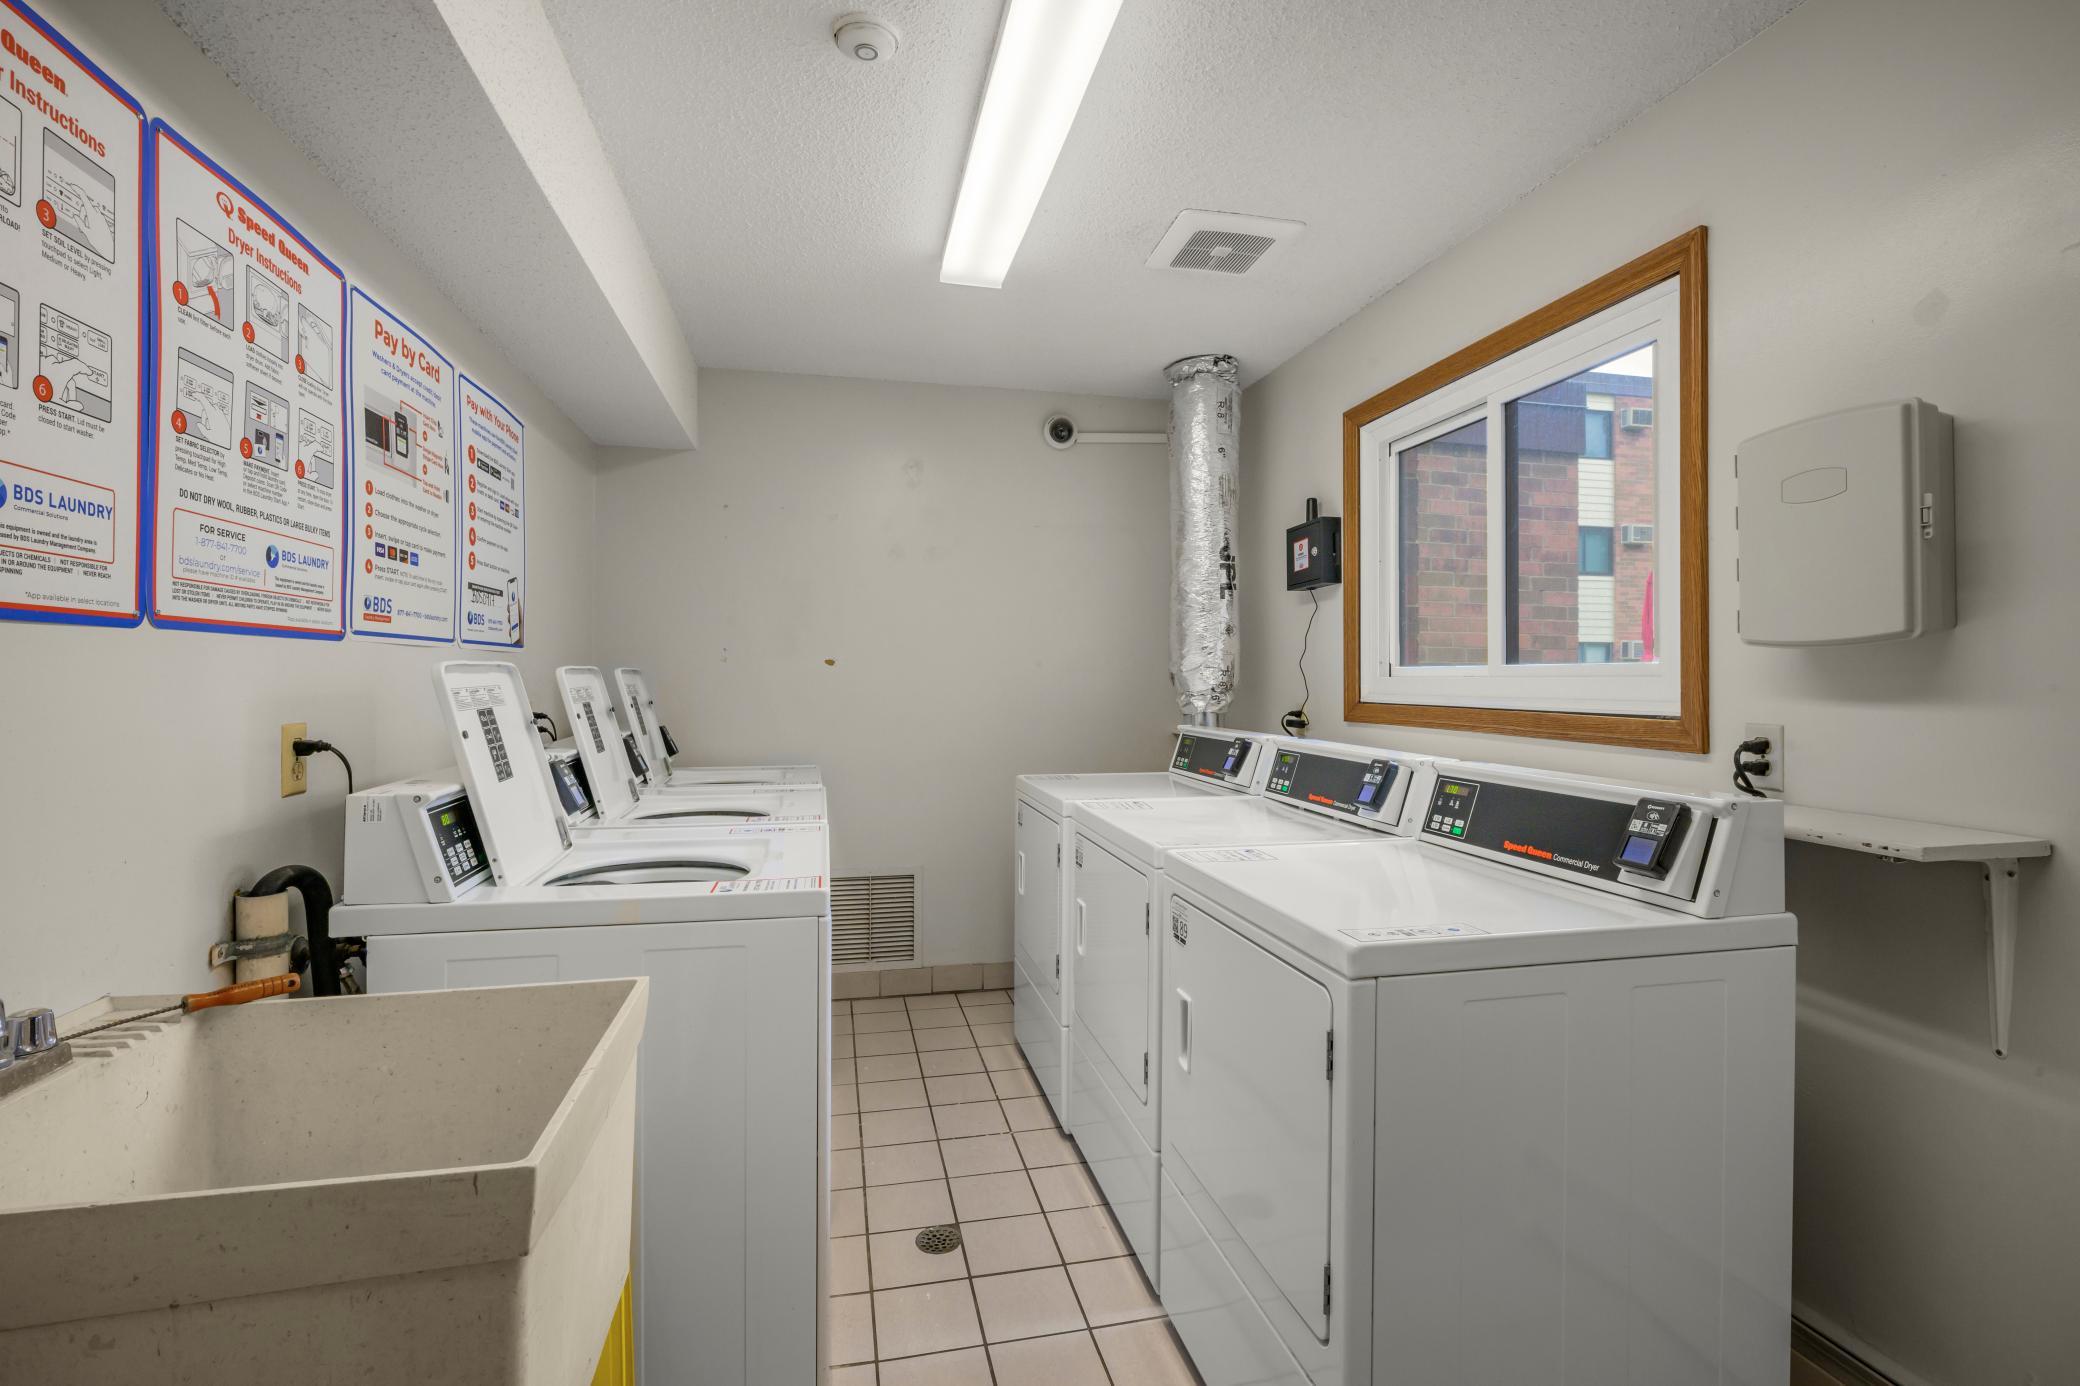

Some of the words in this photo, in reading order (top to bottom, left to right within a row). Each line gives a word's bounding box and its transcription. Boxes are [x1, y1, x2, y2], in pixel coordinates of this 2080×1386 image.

[0, 29, 65, 94] Queen
[10, 70, 105, 156] Instructions
[42, 205, 49, 223] 3
[41, 228, 51, 240] SET
[53, 235, 64, 248] SOIL
[67, 243, 83, 258] LEVEL
[84, 253, 89, 263] by
[237, 206, 275, 247] Speed
[278, 239, 308, 275] Queen
[41, 249, 62, 266] Medium
[73, 258, 87, 271] select
[228, 227, 253, 257] Dryer
[256, 248, 301, 294] Instructions
[177, 306, 192, 319] CLEAN
[374, 319, 398, 355] Pay
[401, 337, 415, 367] by
[418, 352, 439, 383] Card
[39, 382, 46, 397] 6
[1, 408, 15, 420] Code
[38, 403, 57, 416] PRESS
[86, 421, 97, 430] must
[175, 415, 181, 428] 4
[466, 394, 478, 414] Pay
[479, 406, 492, 422] with
[494, 414, 505, 431] Your
[505, 423, 518, 443] Phone
[38, 415, 55, 426] closed
[56, 420, 62, 429] to
[63, 423, 75, 433] start
[175, 435, 183, 443] SET
[184, 438, 198, 449] FABRIC
[199, 444, 219, 456] SELECTOR
[374, 487, 384, 496] Load
[13, 484, 42, 505] BDS
[49, 493, 112, 520] LAUNDRY
[13, 504, 44, 515] Commercial
[45, 511, 68, 520] Solutions
[179, 487, 187, 498] DO
[189, 490, 201, 502] NOT
[203, 494, 215, 505] DRY
[259, 510, 281, 524] PLASTICS
[283, 517, 289, 526] OR
[290, 520, 303, 530] LARGE
[305, 523, 317, 534] BULKY
[318, 528, 330, 538] ITEMS
[374, 508, 389, 519] Choose
[6, 524, 30, 533] equipment
[199, 523, 214, 534] FOR
[217, 527, 245, 541] SERVICE
[15, 560, 36, 568] AROUND
[47, 565, 73, 573] EQUIPMENT
[23, 553, 50, 562] CHEMICALS
[69, 560, 98, 570] RESPONSIBLE
[281, 550, 296, 563] BDS
[298, 554, 328, 569] LAUNDRY
[374, 563, 385, 573] Press
[42, 594, 69, 602] available
[77, 596, 94, 605] select
[373, 596, 392, 614] BDS
[473, 612, 484, 625] BDS
[1503, 839, 1528, 855] Speed
[1526, 844, 1553, 862] Queen
[1552, 853, 1584, 869] Commercial
[1582, 858, 1600, 873] Dryer
